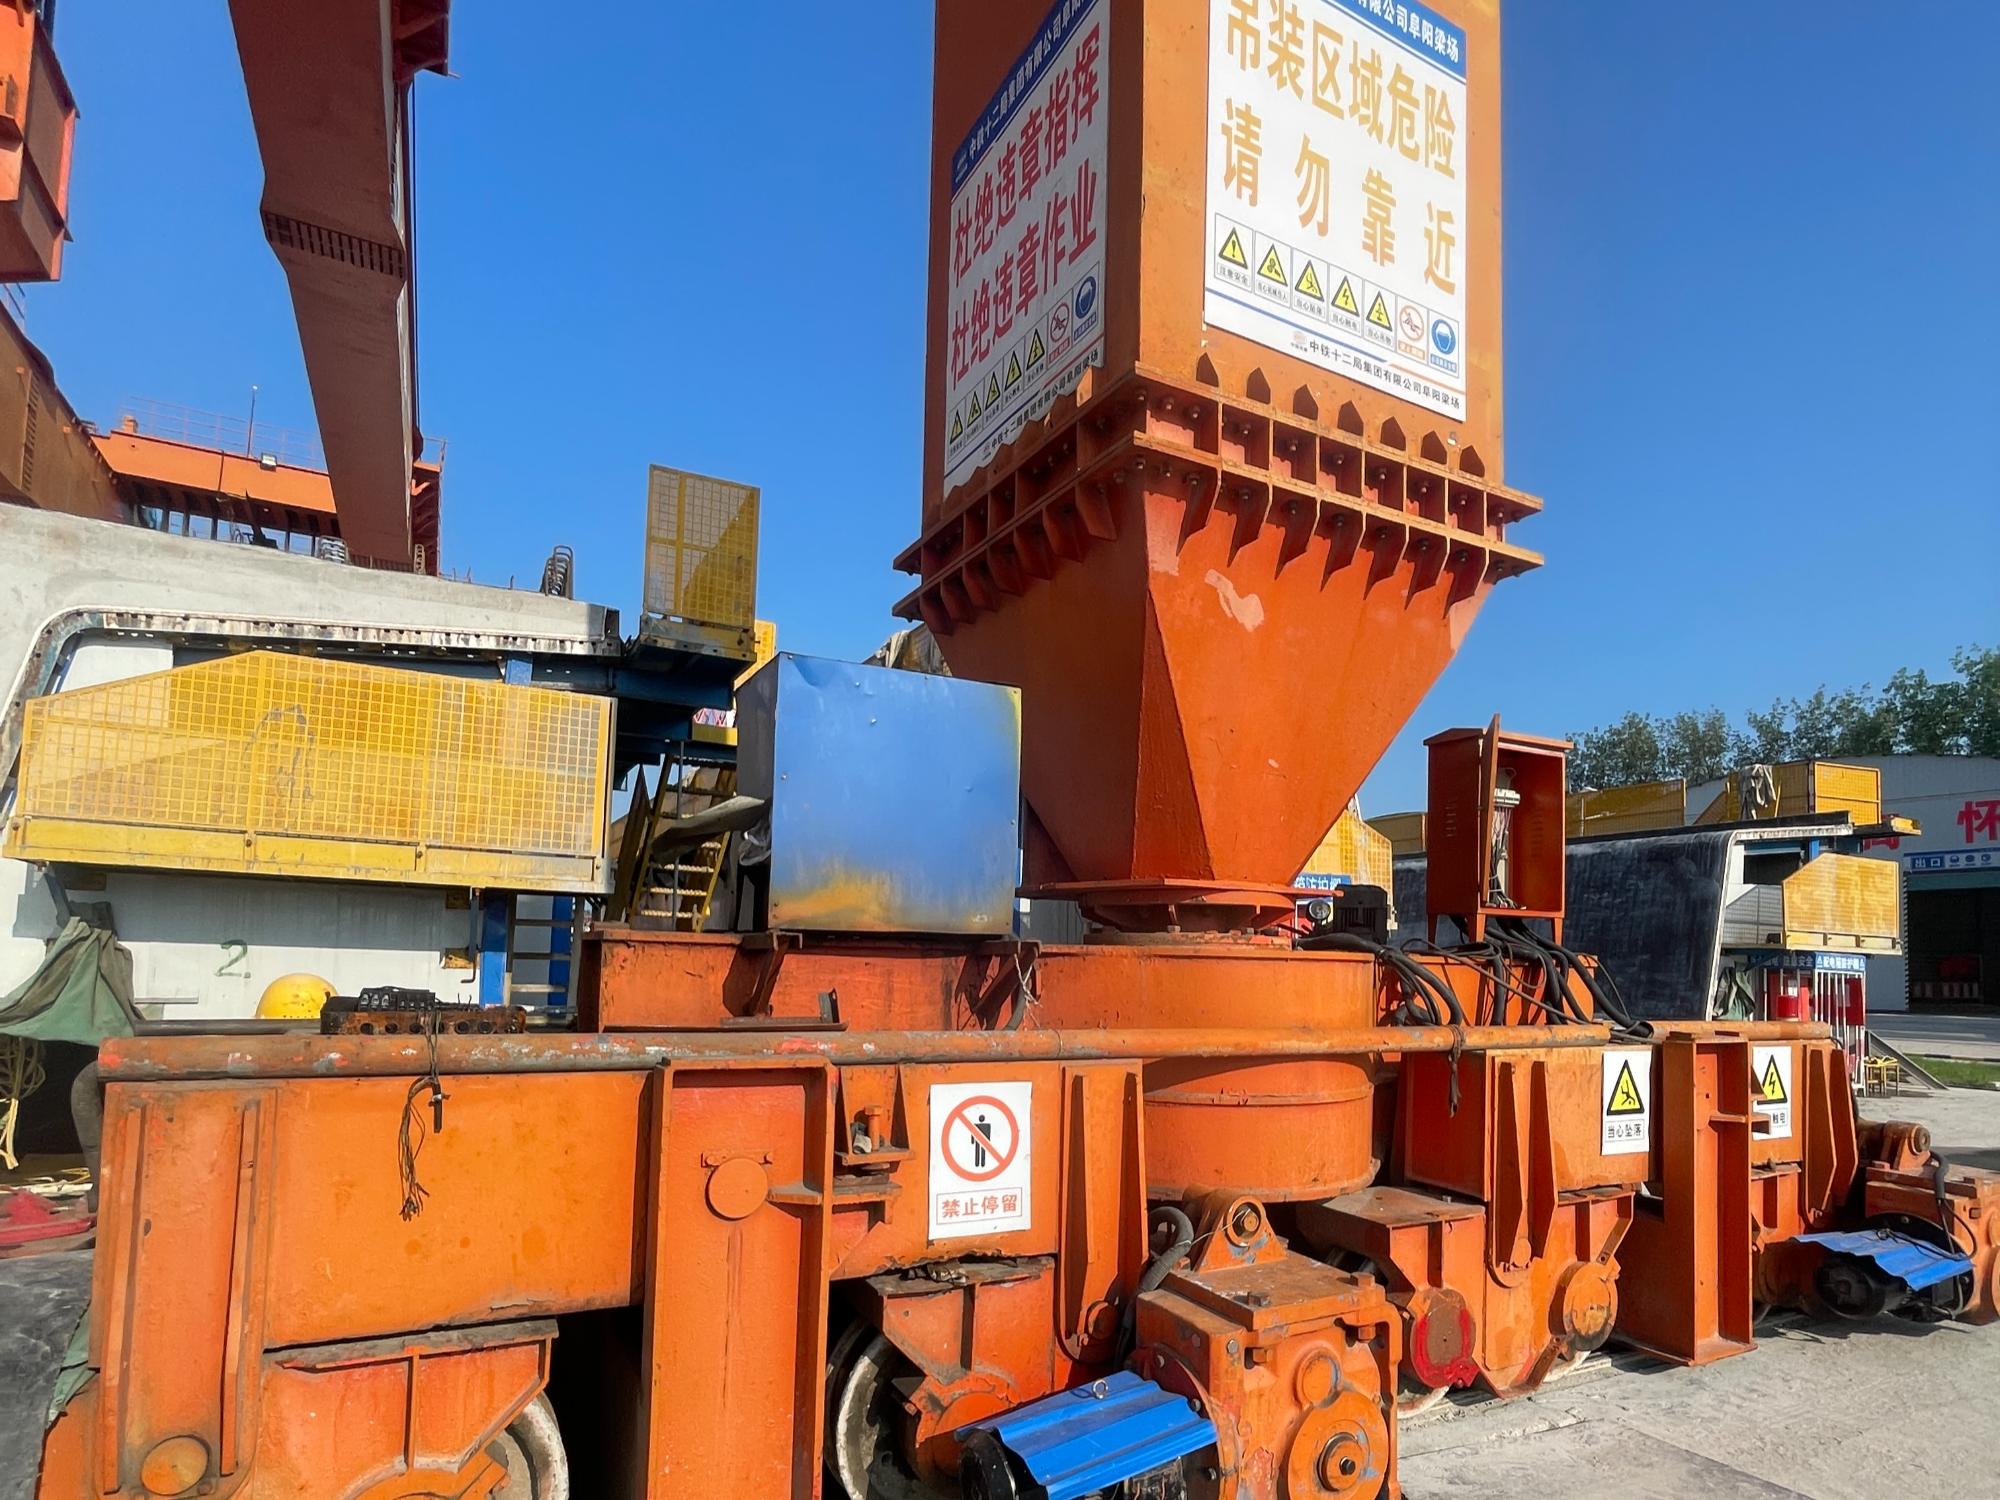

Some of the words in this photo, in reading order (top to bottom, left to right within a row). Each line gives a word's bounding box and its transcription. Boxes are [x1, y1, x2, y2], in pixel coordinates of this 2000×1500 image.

[954, 21, 1100, 288] 杜绝违章指挥
[1226, 0, 1456, 180] 吊装区域危险
[950, 157, 1098, 391] 杜绝违章作业
[1221, 97, 1456, 295] 请勿靠近
[1309, 340, 1460, 410] 中铁十二局集团有限公司阜阳梁场
[941, 1194, 1018, 1218] 禁止停留
[1607, 1123, 1643, 1139] 当心坠落
